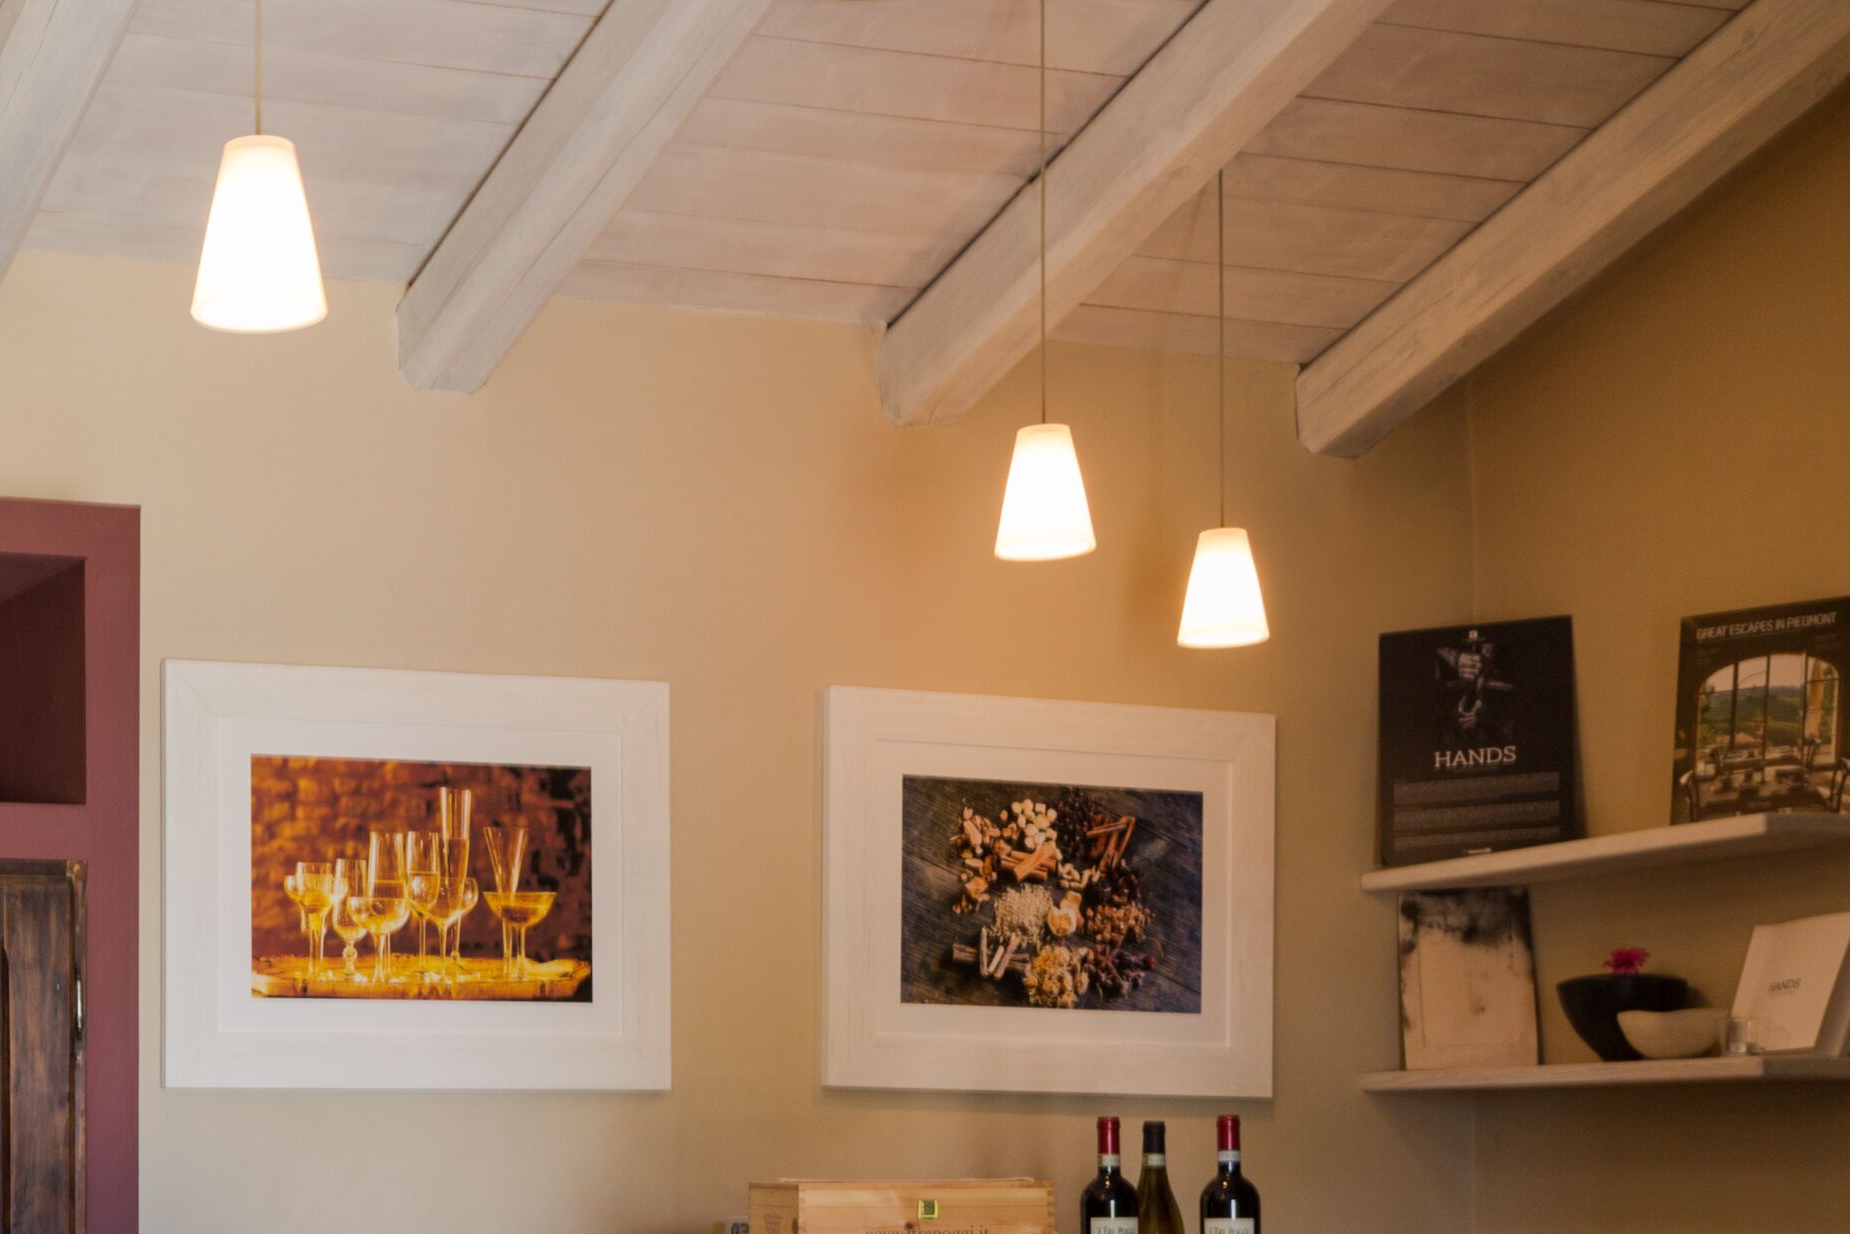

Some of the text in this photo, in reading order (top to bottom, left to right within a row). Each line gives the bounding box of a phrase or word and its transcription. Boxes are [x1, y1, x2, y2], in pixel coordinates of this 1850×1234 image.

[1696, 611, 1838, 640] GREAT ESCAPES IN PIEDMONT
[1434, 745, 1517, 769] HANDS
